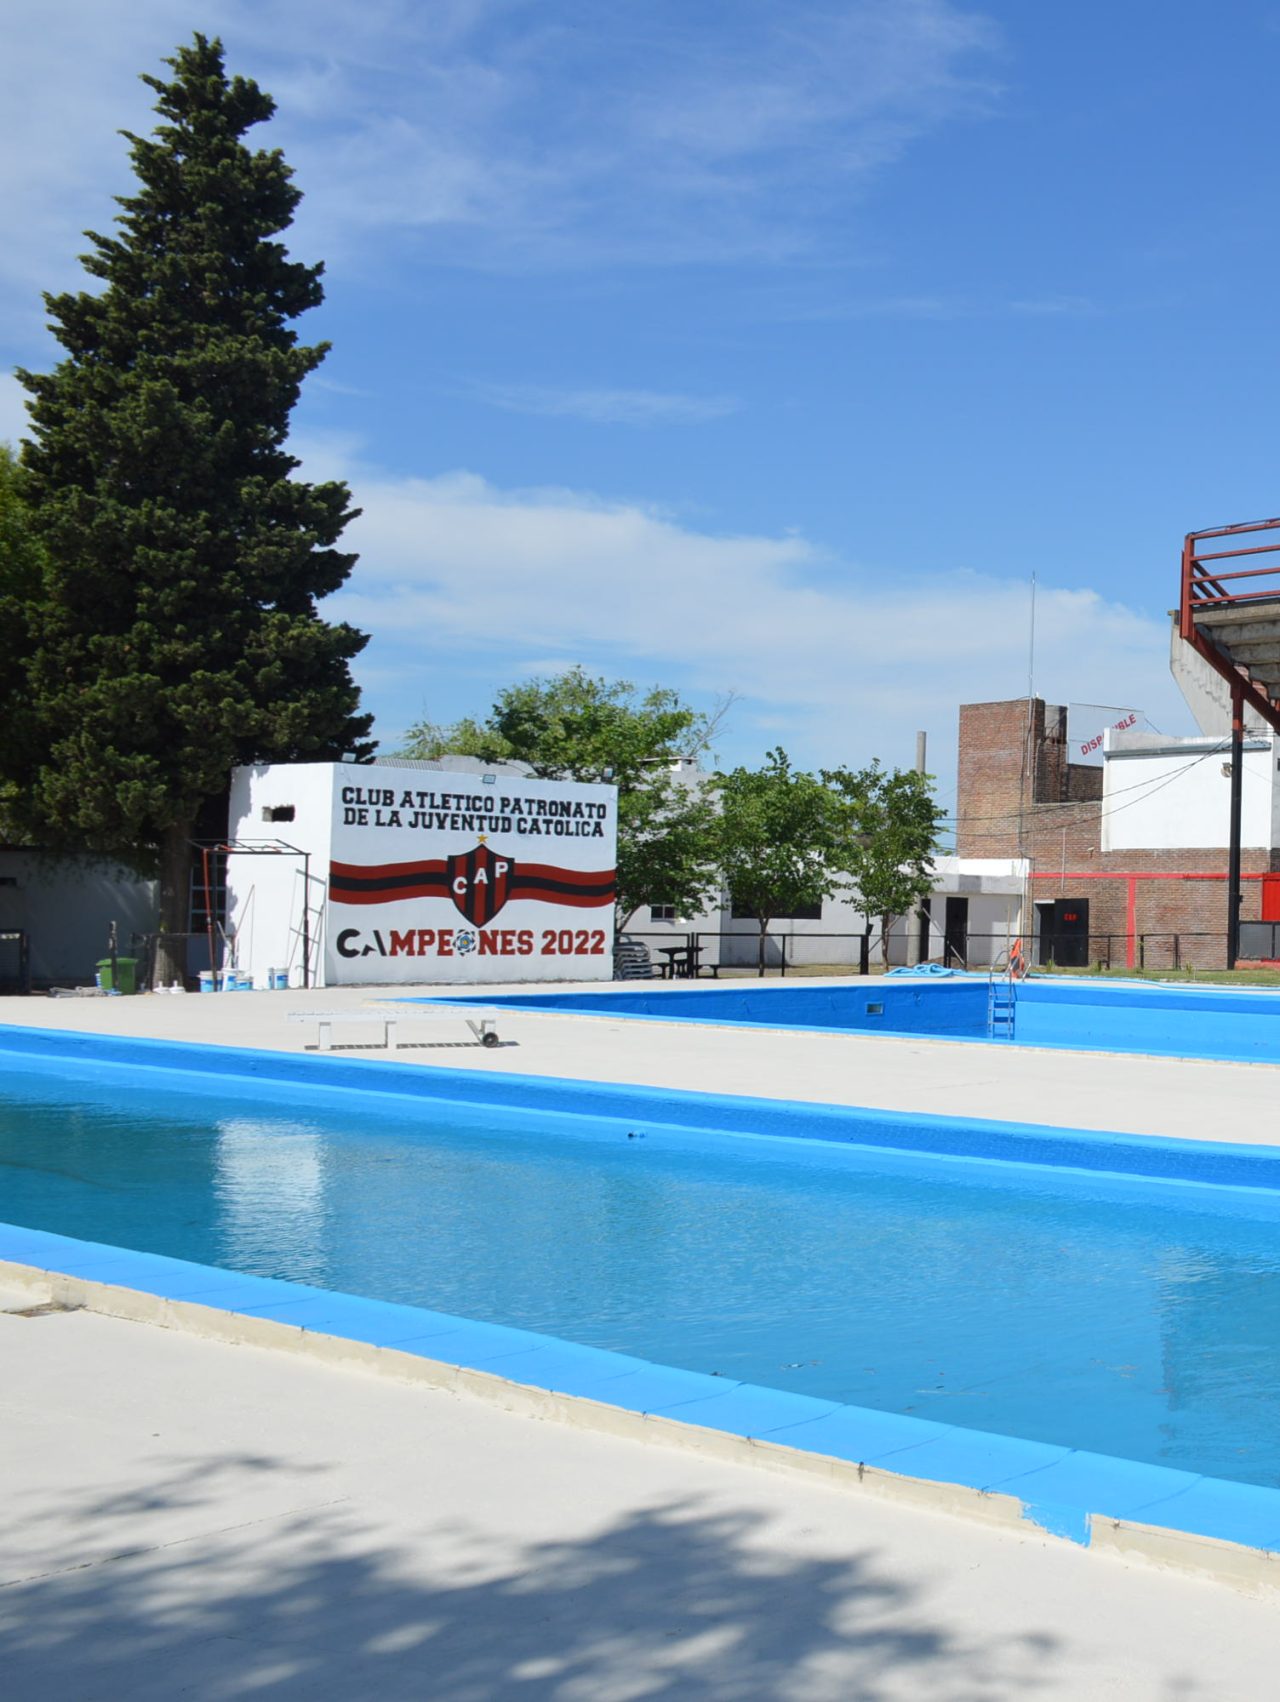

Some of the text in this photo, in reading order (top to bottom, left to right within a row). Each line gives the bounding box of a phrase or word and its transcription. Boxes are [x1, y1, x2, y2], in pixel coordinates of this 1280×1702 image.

[1080, 713, 1137, 756] DISPBLE
[341, 786, 607, 819] CLUB ATLETICO PATRONATO
[343, 807, 604, 838] DE LA JUVENTUD CATOLICA
[452, 861, 509, 895] CAP
[540, 929, 606, 956] 2022
